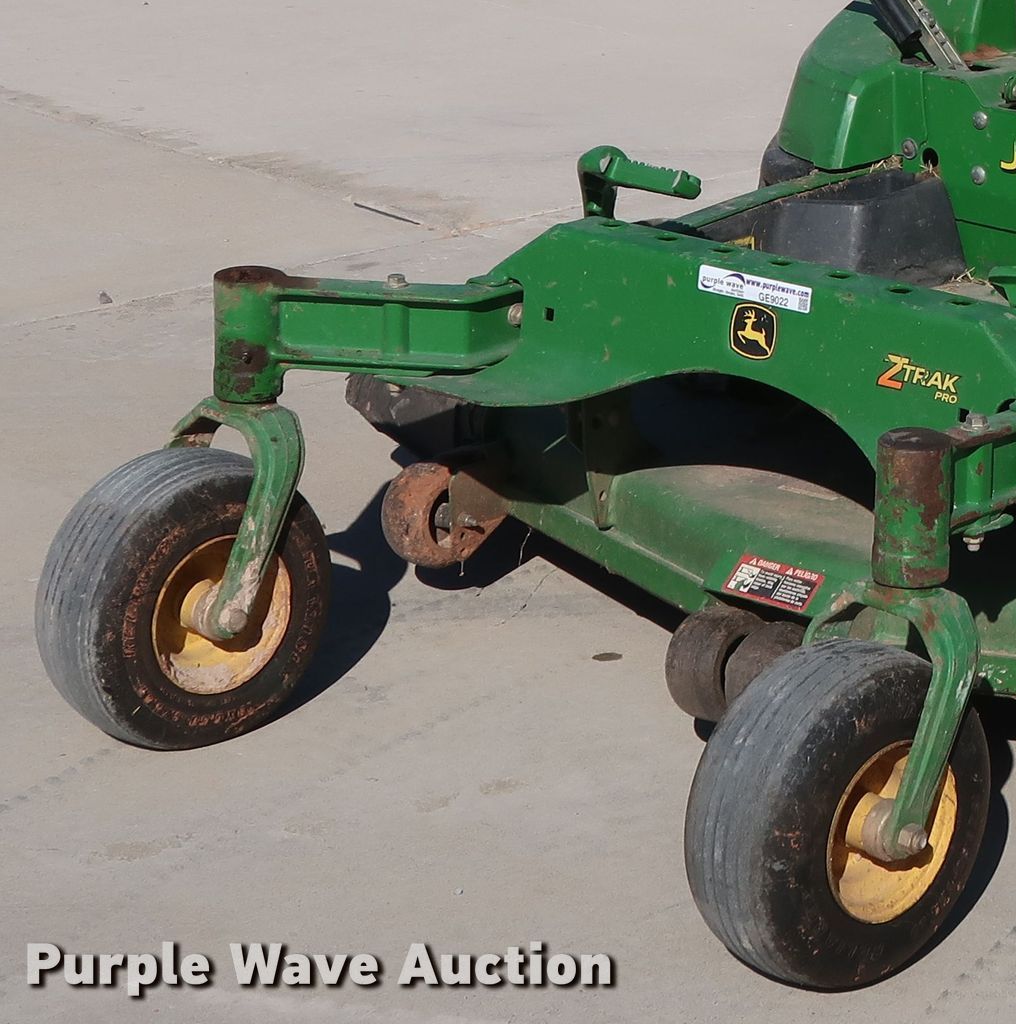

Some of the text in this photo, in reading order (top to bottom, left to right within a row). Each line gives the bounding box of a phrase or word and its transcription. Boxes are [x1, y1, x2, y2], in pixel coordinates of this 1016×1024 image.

[702, 275, 744, 290] purple wave
[746, 278, 810, 298] www.purplewave.com
[758, 292, 789, 307] GE9022
[934, 391, 958, 404] PRO
